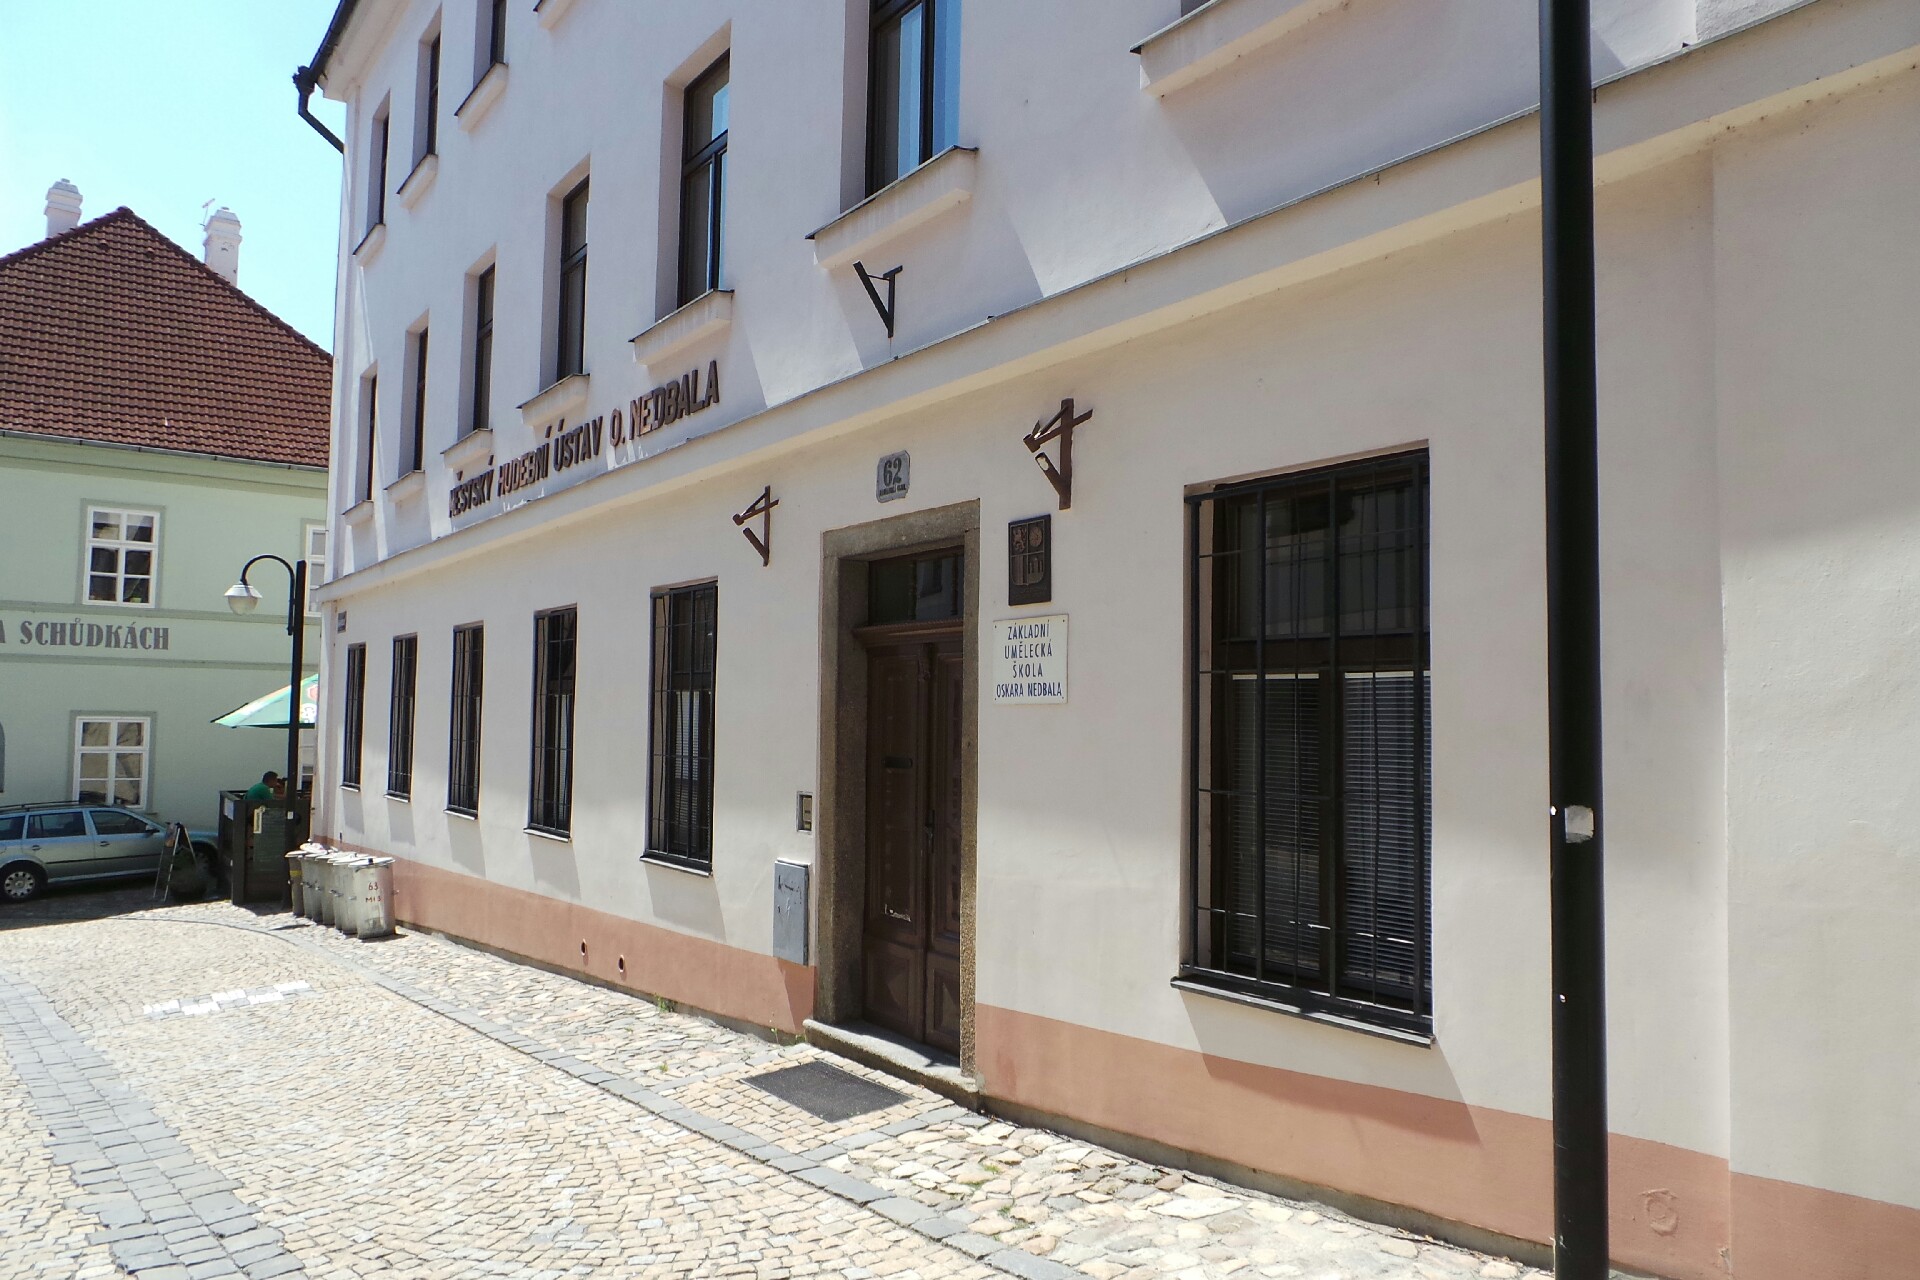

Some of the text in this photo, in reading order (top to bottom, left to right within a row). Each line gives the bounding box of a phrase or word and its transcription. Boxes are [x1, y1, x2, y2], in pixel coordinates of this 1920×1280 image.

[497, 425, 552, 497] HUDEBNÍ
[554, 417, 603, 472] ÚSTAV
[610, 408, 626, 447] O.
[629, 360, 719, 440] NEDBALA
[883, 457, 902, 487] 62
[20, 617, 169, 650] SCHŮDKÁCH
[1008, 619, 1050, 640] ZÁKLADNÍ
[1004, 639, 1052, 659] UMĚLECKÁ
[1012, 660, 1043, 679] ŠKOLA
[996, 682, 1062, 698] OSKARA NEDBALA
